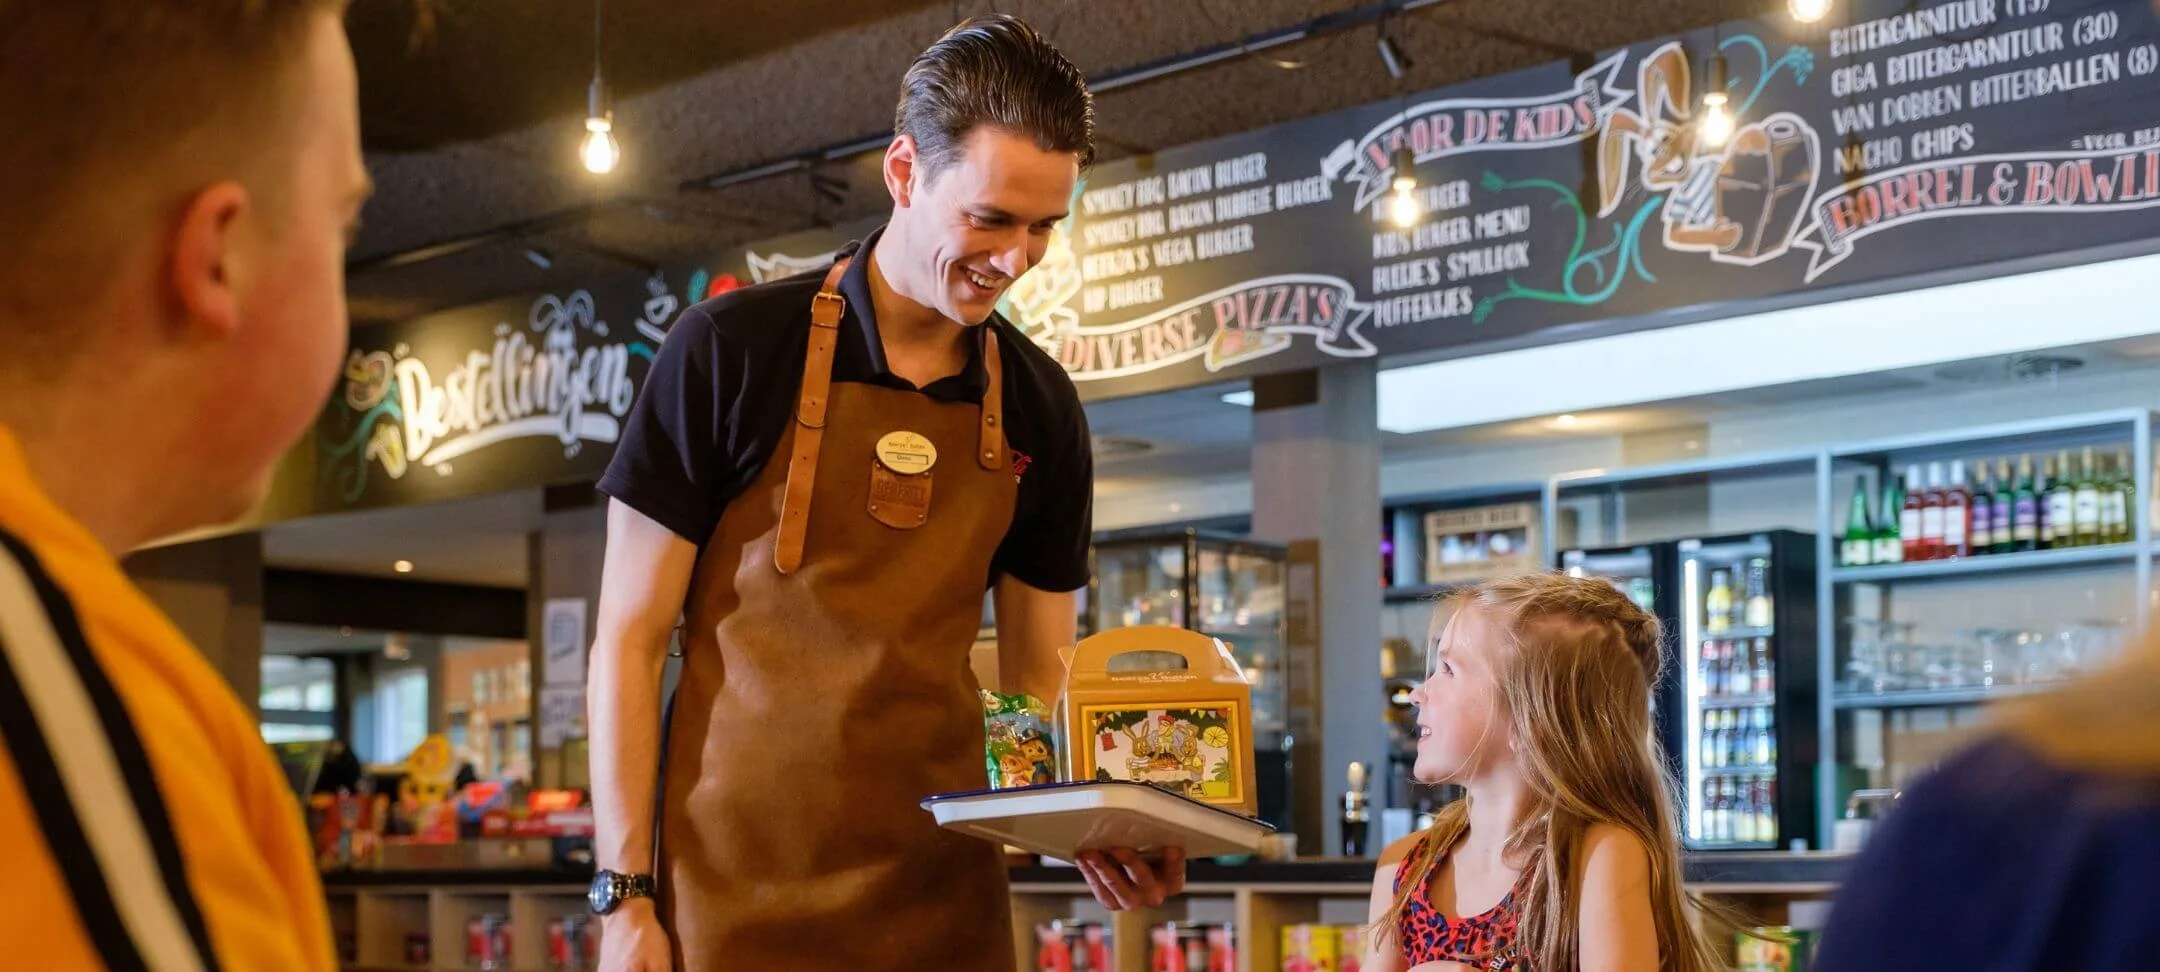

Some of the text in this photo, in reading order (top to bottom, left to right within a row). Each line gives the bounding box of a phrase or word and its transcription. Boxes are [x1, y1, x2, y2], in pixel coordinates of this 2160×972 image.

[1829, 0, 1997, 58] BITTERGARNITUUR
[1831, 11, 2119, 97] GIGA BITTERGARNITUUR (30)
[1831, 44, 2159, 136] VAN DOBBEN BITTERBALLEN (8)
[1464, 107, 1510, 144] DE
[1513, 96, 1596, 142] KIDS
[1833, 123, 1975, 174] NACHO CHIPS
[1167, 164, 1212, 200] BACON
[1214, 152, 1267, 189] BURGER
[1275, 174, 1333, 211] BURGER
[1828, 164, 1982, 235] BORREL
[1987, 162, 2020, 207] &
[1152, 235, 1195, 268] VEGA
[1196, 223, 1255, 260] BURGER
[1412, 215, 1473, 252] BURGER
[1474, 204, 1531, 241] MENU
[1108, 275, 1165, 310] BURGER
[1062, 284, 1337, 372] DIVERSE PIZZA'S
[396, 330, 635, 463] Bestellingen
